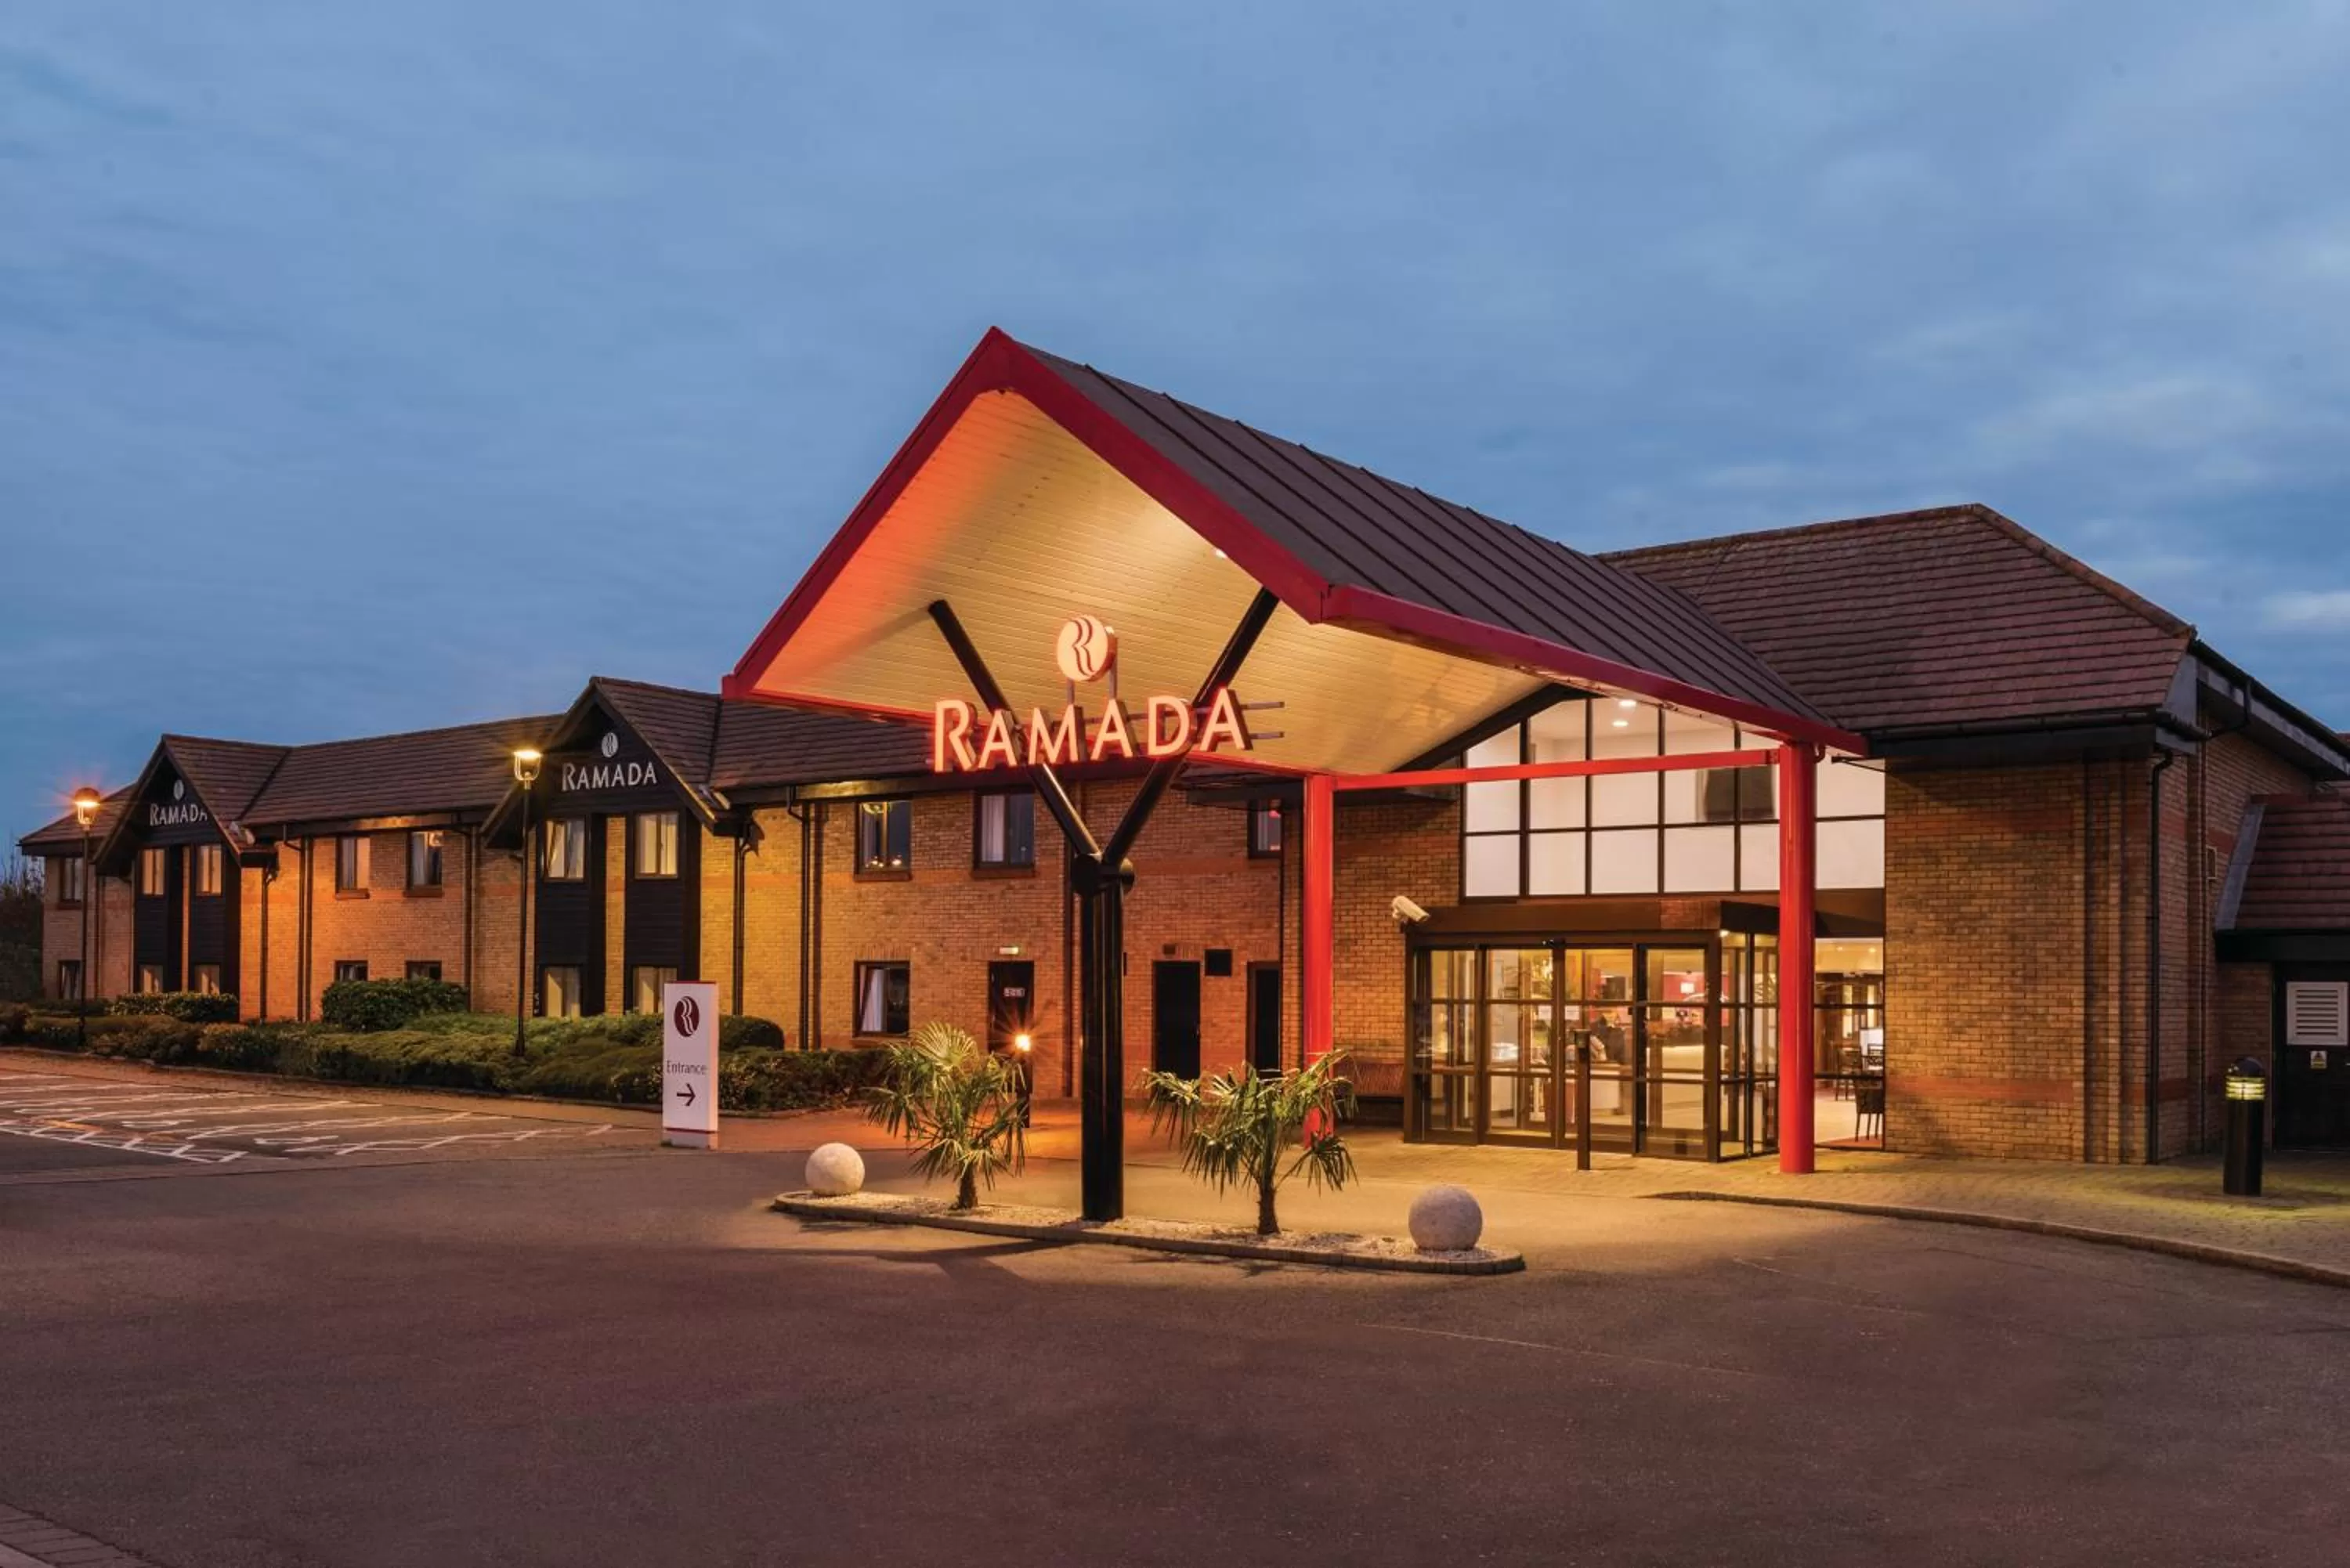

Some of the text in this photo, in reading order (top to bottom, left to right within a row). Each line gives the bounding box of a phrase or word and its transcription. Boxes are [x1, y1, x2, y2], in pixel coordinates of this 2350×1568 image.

[935, 688, 1251, 772] RAMADA
[562, 761, 657, 791] RAMADA
[667, 1060, 707, 1075] Entrance
